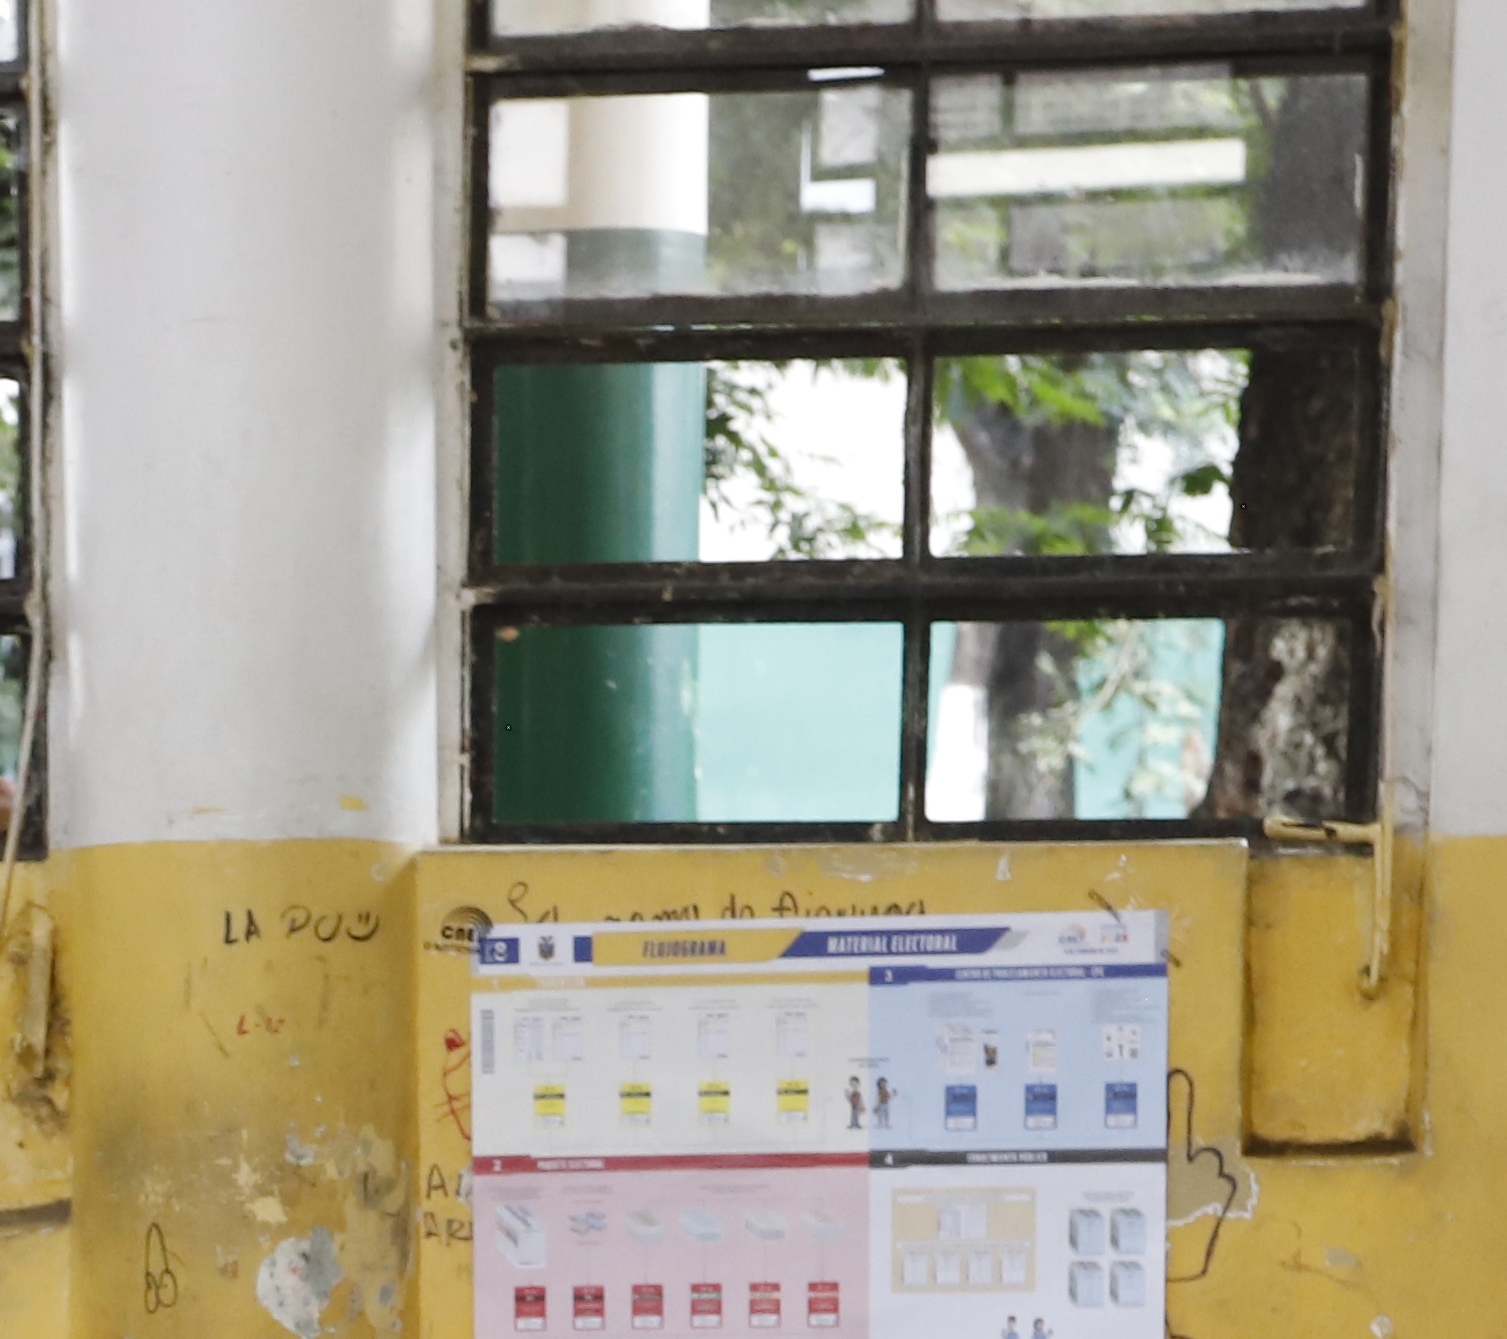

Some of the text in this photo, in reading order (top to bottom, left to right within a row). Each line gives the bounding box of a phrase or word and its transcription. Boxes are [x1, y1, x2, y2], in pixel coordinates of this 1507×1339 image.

[224, 908, 261, 944] LA
[826, 936, 886, 954] MATERIAL
[891, 934, 957, 952] ELECTORAL
